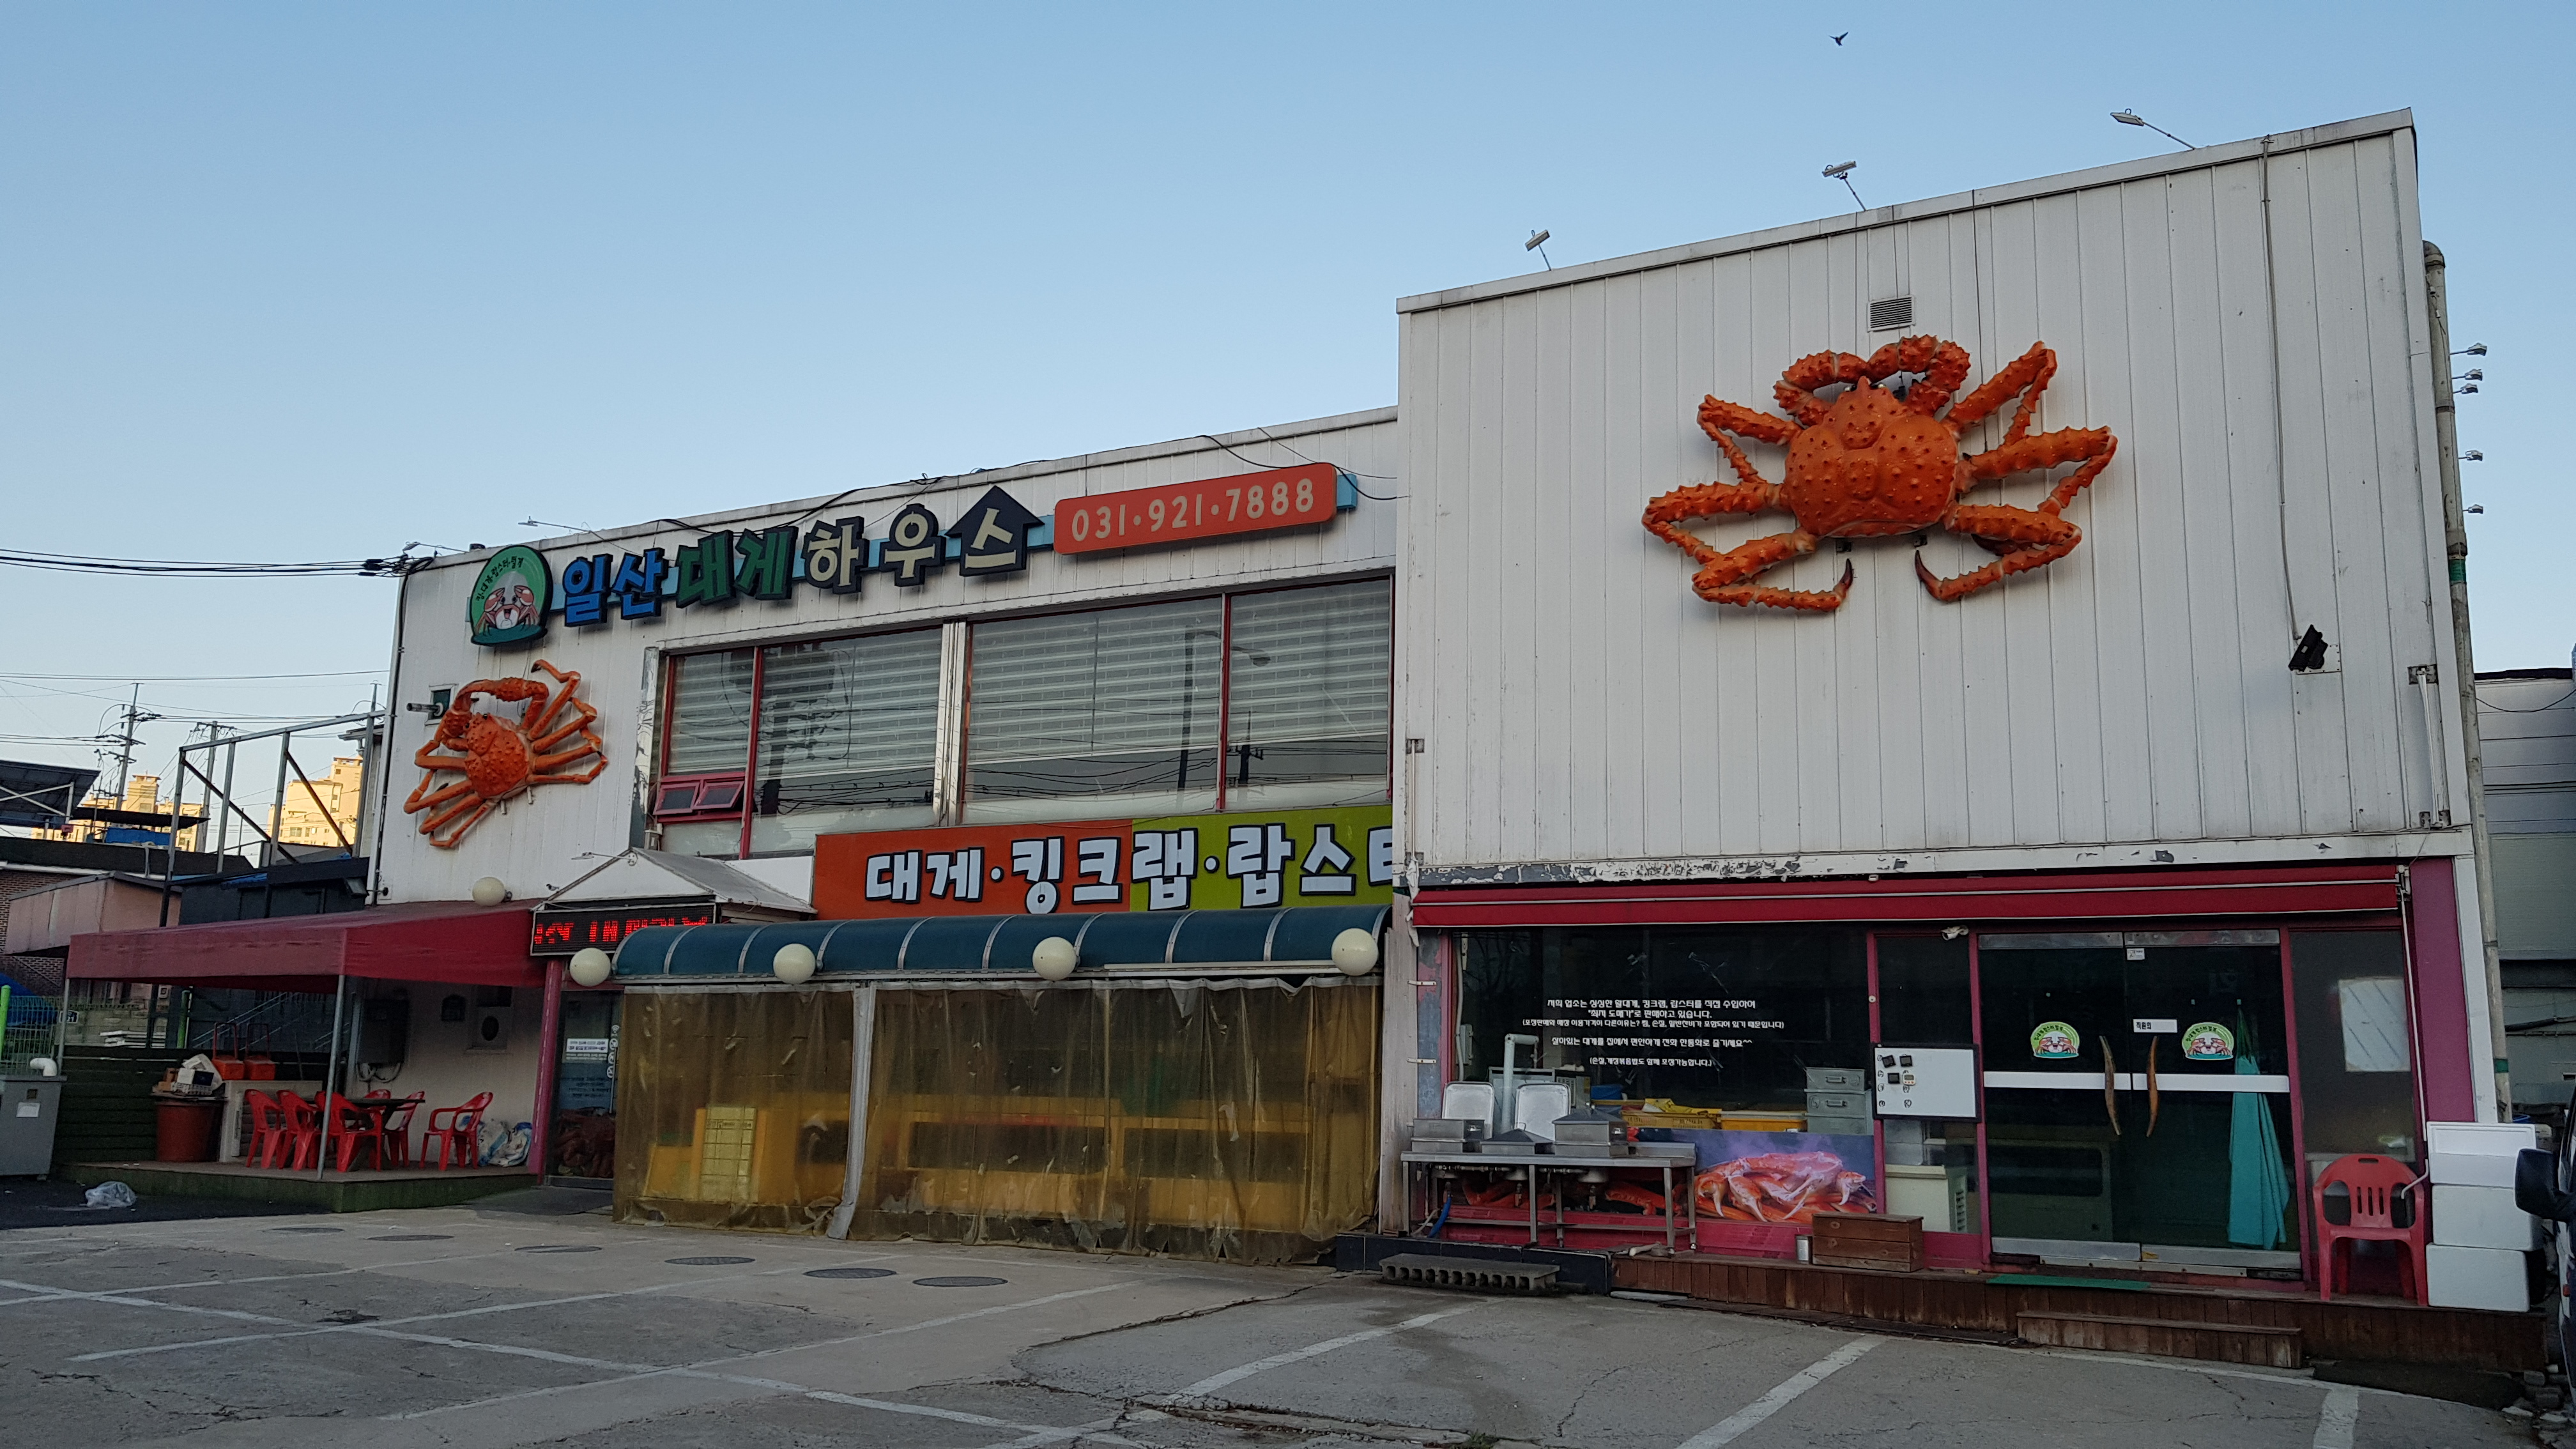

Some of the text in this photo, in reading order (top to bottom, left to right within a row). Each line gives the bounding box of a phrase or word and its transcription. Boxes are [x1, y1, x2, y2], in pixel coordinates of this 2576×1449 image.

[563, 549, 666, 626] 일산
[1547, 999, 1563, 1008] 저희
[1565, 999, 1588, 1008] 업소는
[1590, 999, 1613, 1008] 싱싱한
[1643, 1000, 1668, 1009] 킹크랩,
[1670, 1000, 1702, 1009] 랍스터를
[1704, 1000, 1721, 1009] 직접
[1722, 1000, 1756, 1009] 수입하여
[1644, 1010, 1675, 1018] 판매하고
[1677, 1010, 1713, 1019] 있습니다.
[1551, 1037, 1581, 1046] 살아있는
[1582, 1038, 1604, 1046] 대게를
[1606, 1038, 1629, 1046] 집에서
[1630, 1038, 1660, 1046] 편안하게
[1662, 1038, 1678, 1047] 전화
[1680, 1039, 1710, 1047] 한통화로
